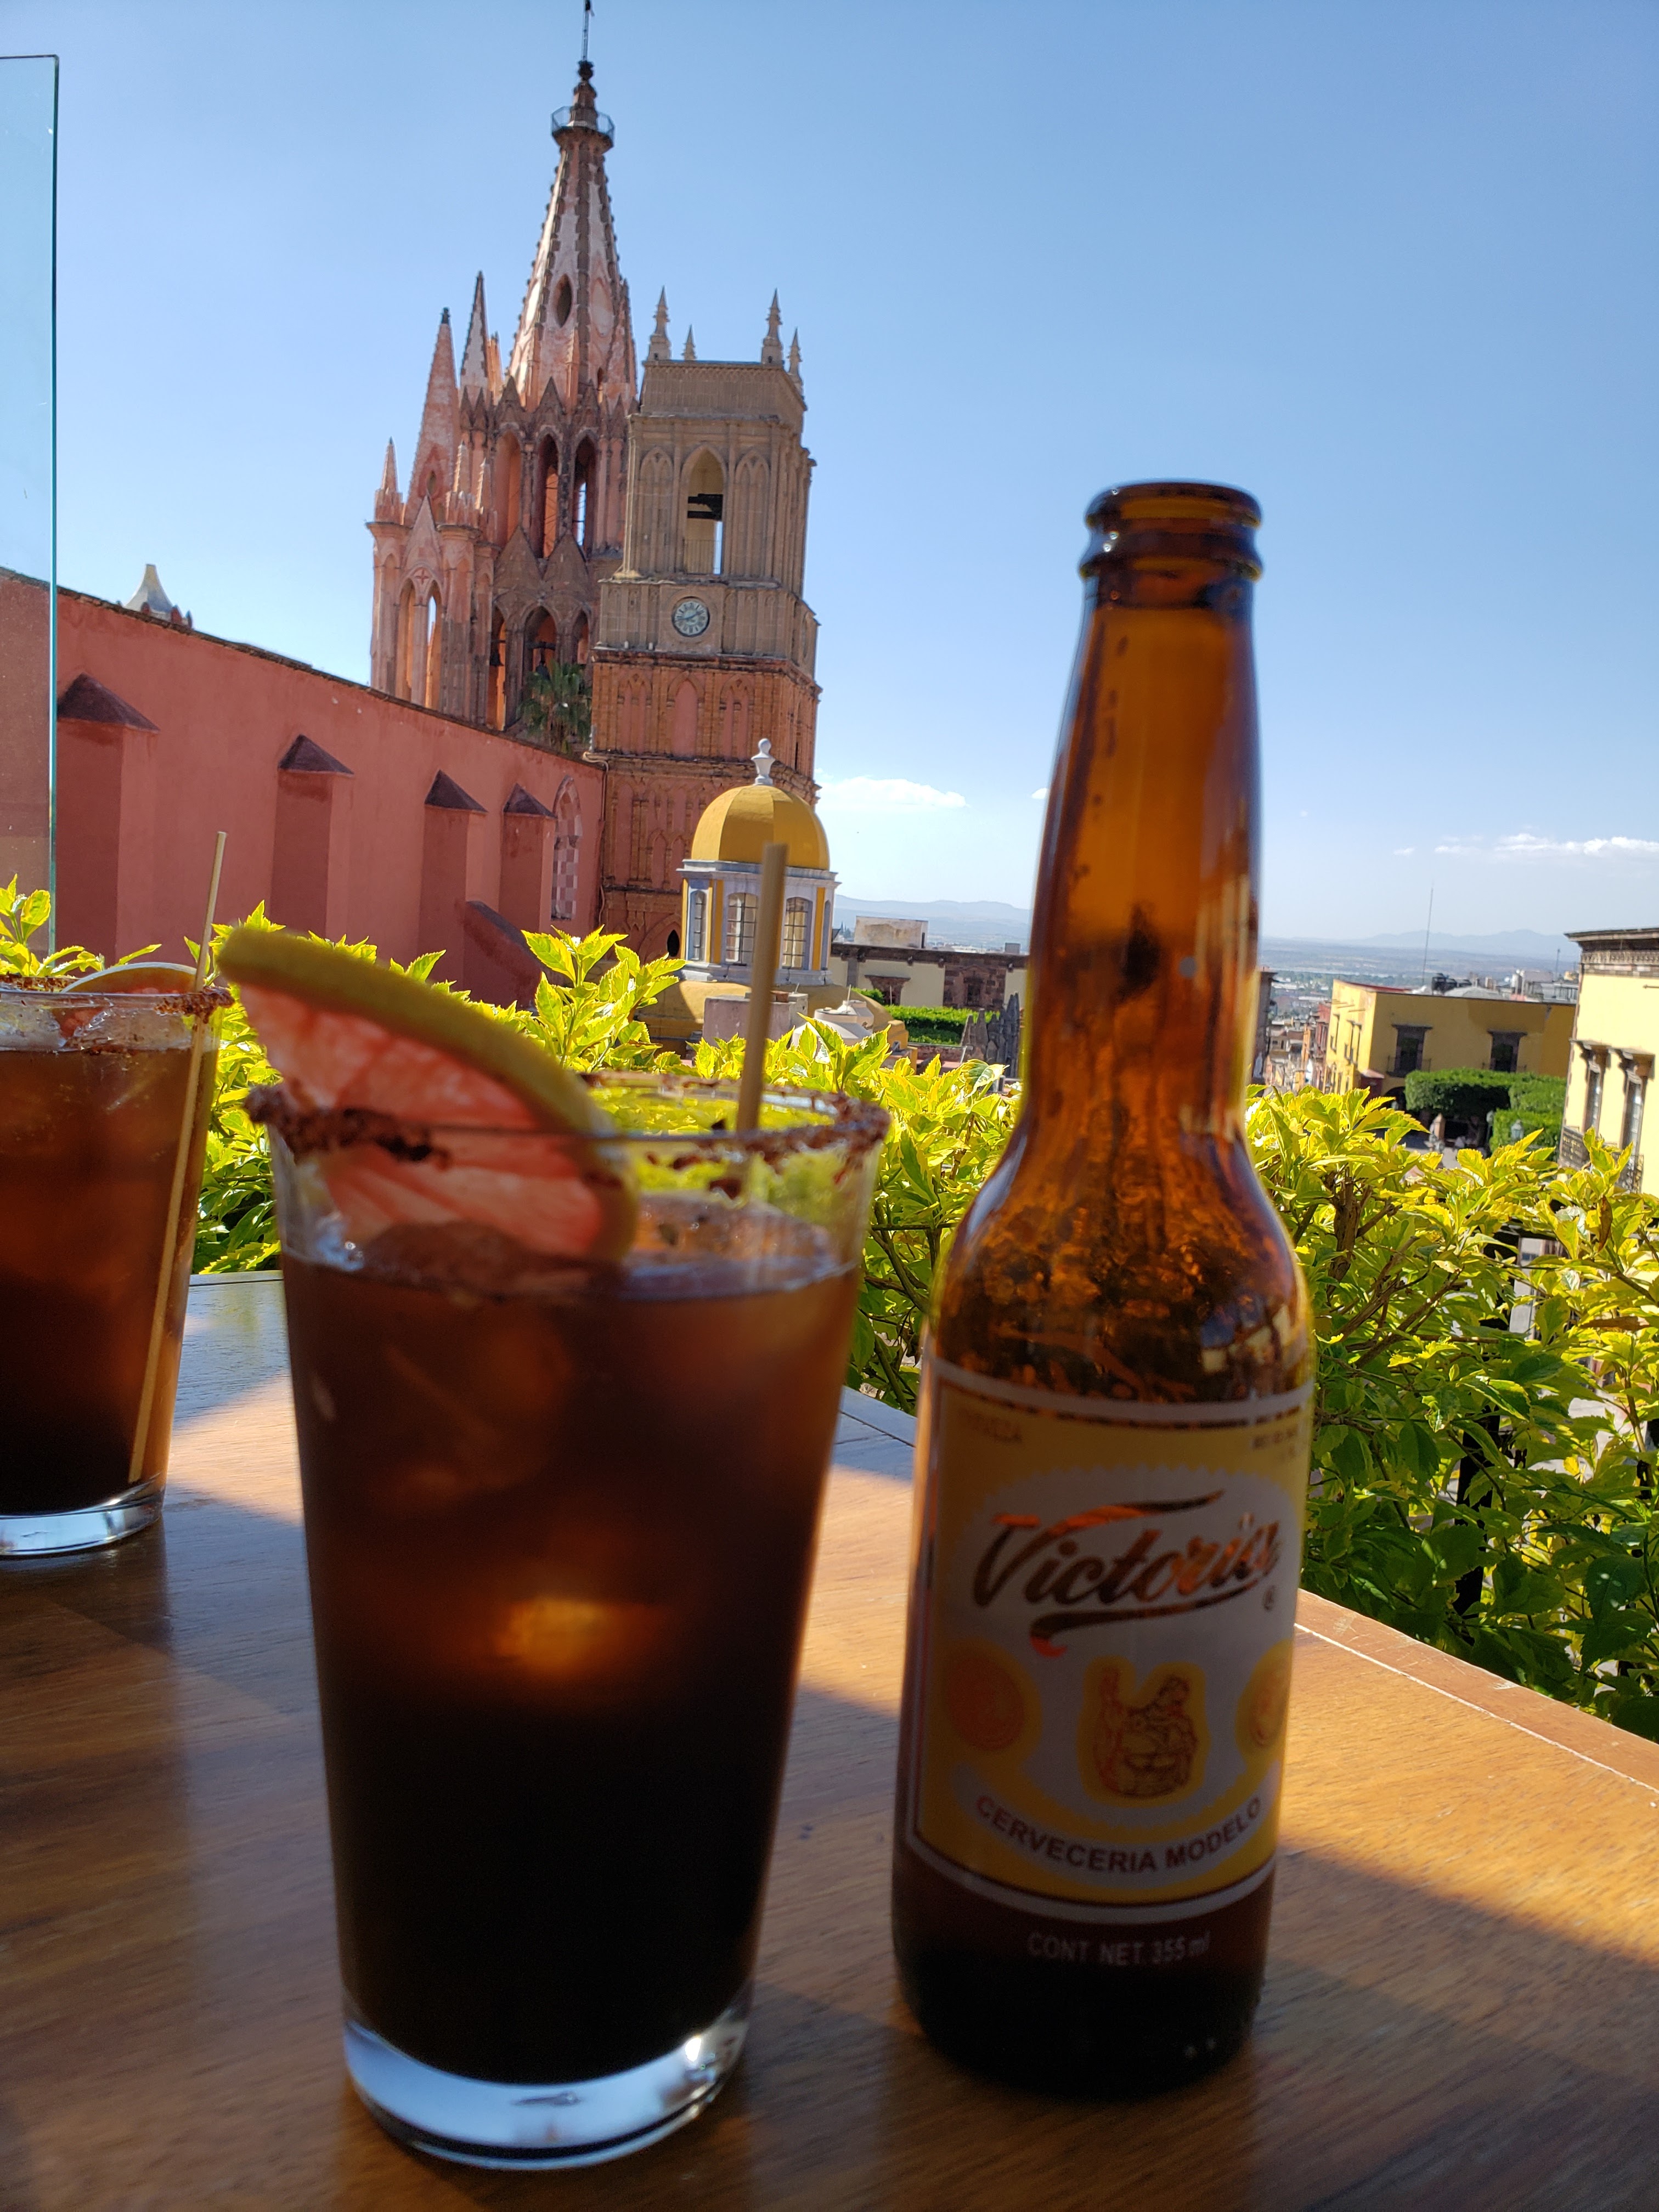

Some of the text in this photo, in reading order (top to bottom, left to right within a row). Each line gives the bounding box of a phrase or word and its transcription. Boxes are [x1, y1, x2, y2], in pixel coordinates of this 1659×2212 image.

[973, 1490, 1280, 1609] Victoria
[975, 1795, 1261, 1872] CERVECERIA MODELO
[1027, 1931, 1090, 1964] CONT
